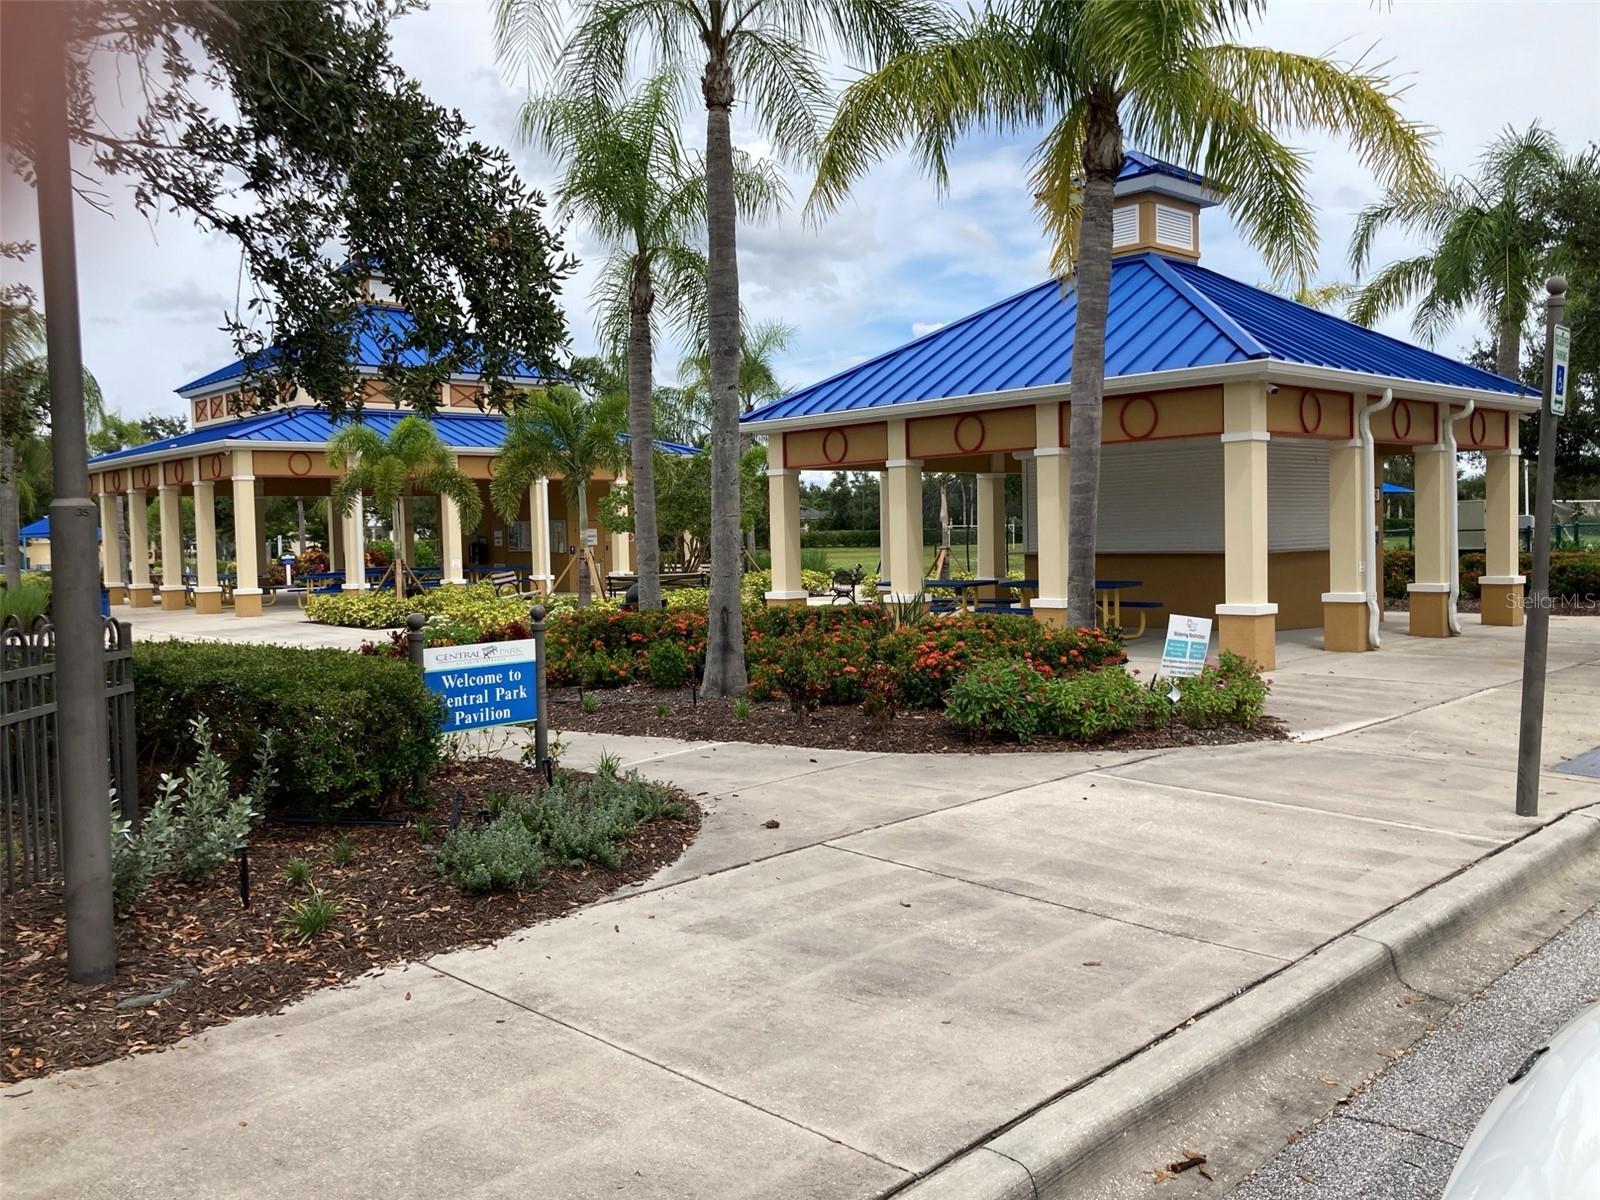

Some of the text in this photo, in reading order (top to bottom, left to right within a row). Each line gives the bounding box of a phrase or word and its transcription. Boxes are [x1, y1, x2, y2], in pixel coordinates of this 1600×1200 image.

[436, 646, 522, 661] CENTRAL PARK
[441, 669, 521, 689] Welcome to
[443, 684, 527, 708] entral Park
[455, 707, 511, 726] Pavilion
